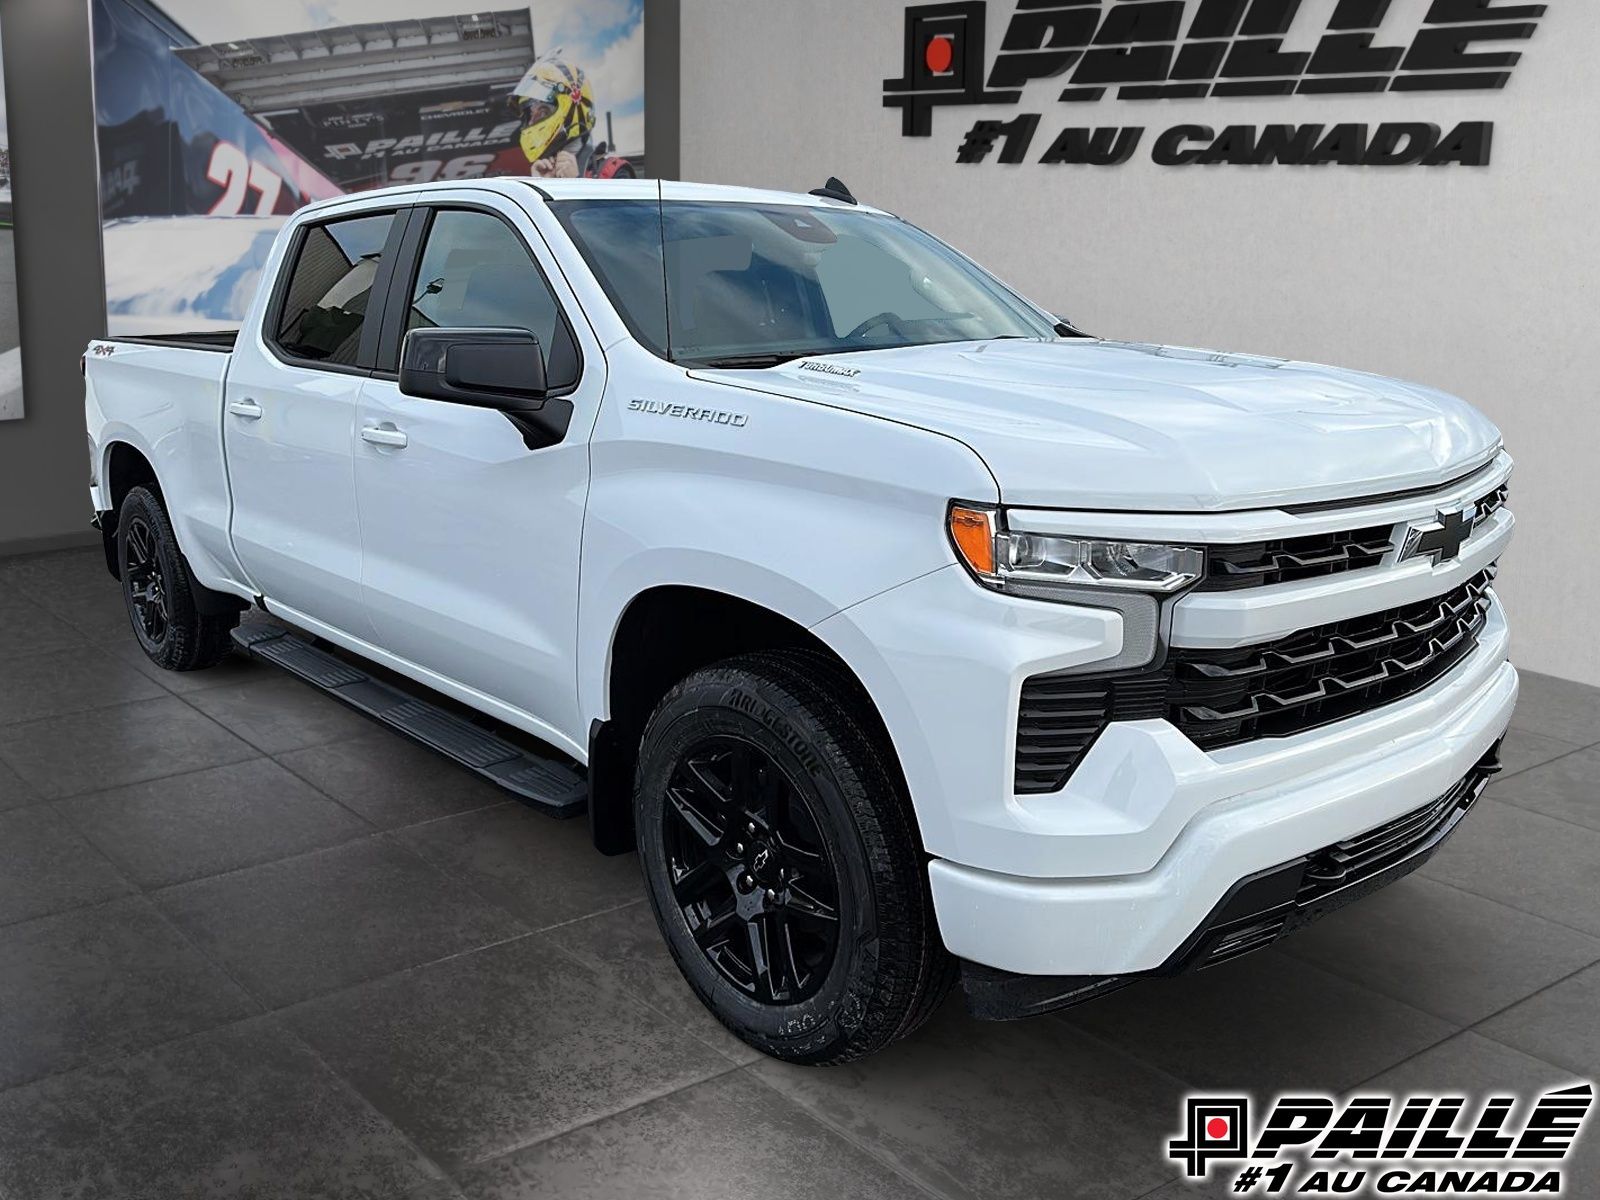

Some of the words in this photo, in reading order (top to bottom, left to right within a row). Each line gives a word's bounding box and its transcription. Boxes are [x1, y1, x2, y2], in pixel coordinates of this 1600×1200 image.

[420, 107, 491, 121] CHEVROLET
[391, 147, 420, 157] AU
[427, 137, 512, 152] CANADA
[955, 113, 1042, 165] #1
[1038, 126, 1145, 165] AU
[1150, 120, 1495, 167] CANADA
[207, 140, 283, 216] 27
[627, 399, 749, 427] SILVERADO
